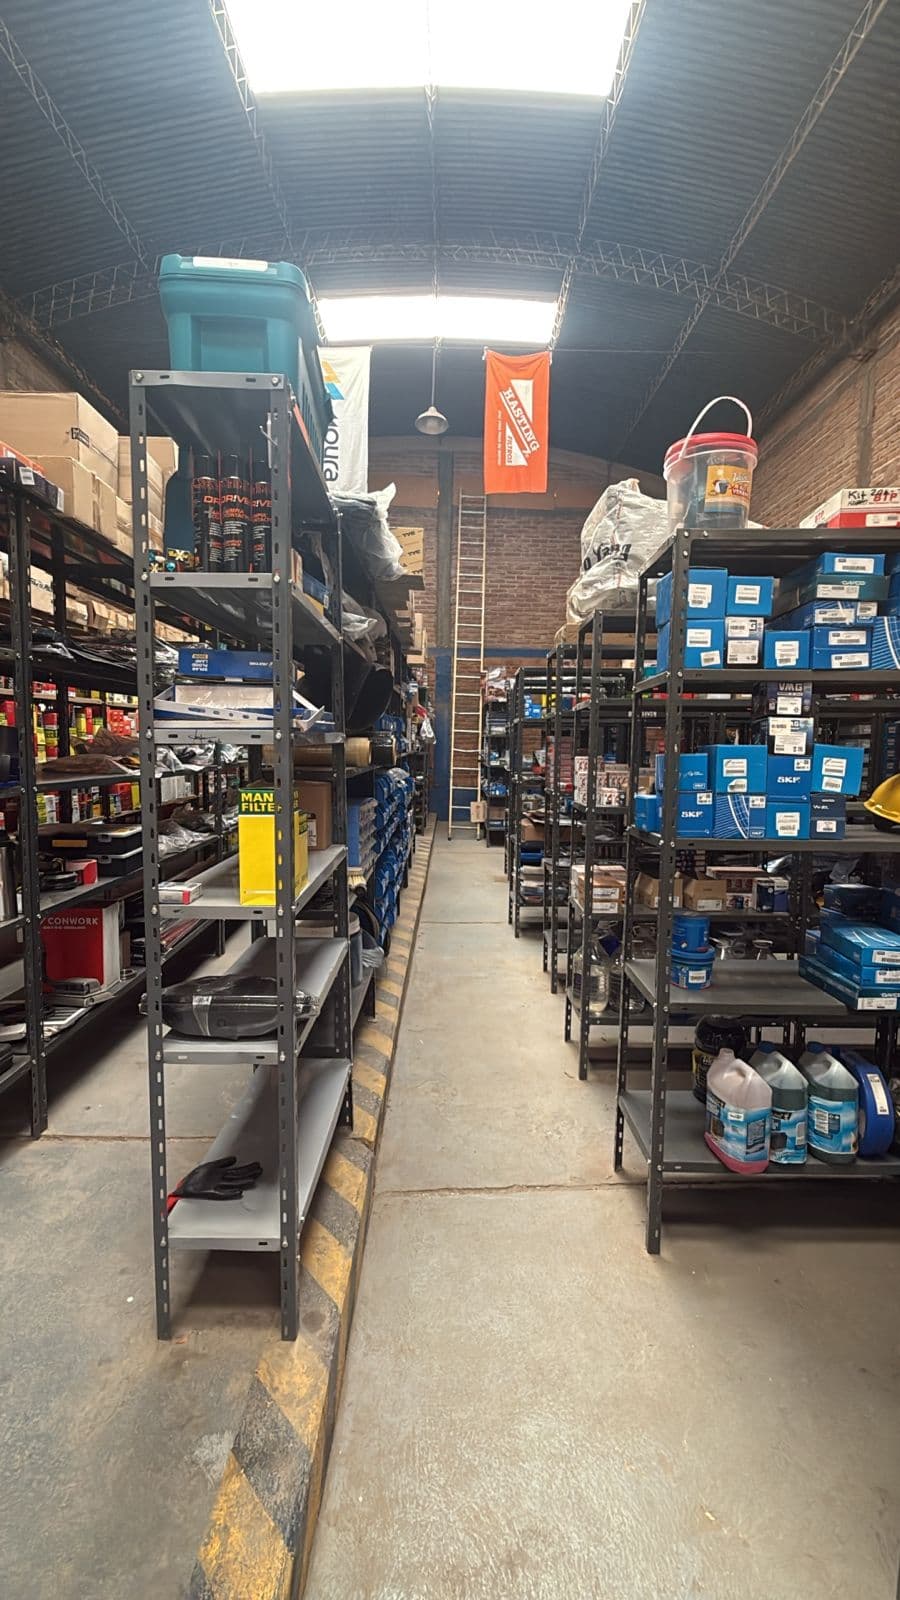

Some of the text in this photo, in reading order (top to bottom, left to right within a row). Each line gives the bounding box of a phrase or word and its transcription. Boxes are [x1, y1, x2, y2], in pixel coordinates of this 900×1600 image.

[848, 490, 867, 500] Kit
[777, 776, 800, 784] SKF
[241, 792, 274, 803] MAN
[241, 802, 282, 813] FILTE
